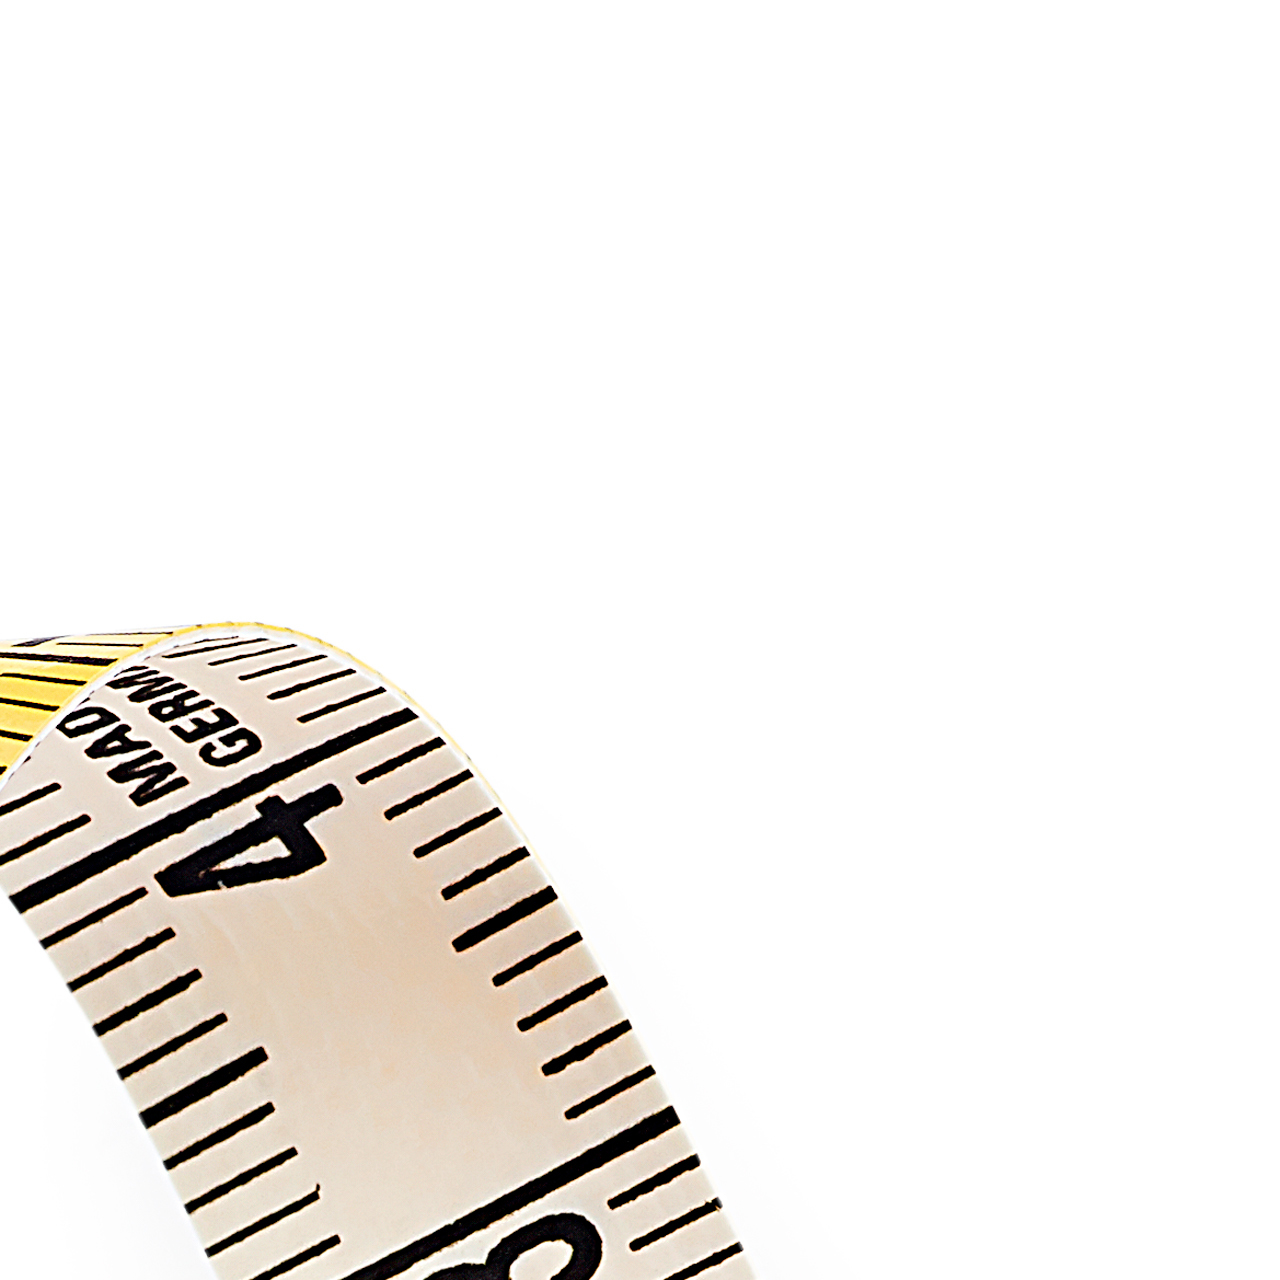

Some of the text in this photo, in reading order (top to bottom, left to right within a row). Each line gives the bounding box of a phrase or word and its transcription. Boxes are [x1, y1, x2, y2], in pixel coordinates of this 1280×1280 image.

[56, 699, 190, 807] MAD
[106, 665, 263, 768] GERM
[153, 782, 344, 898] 4
